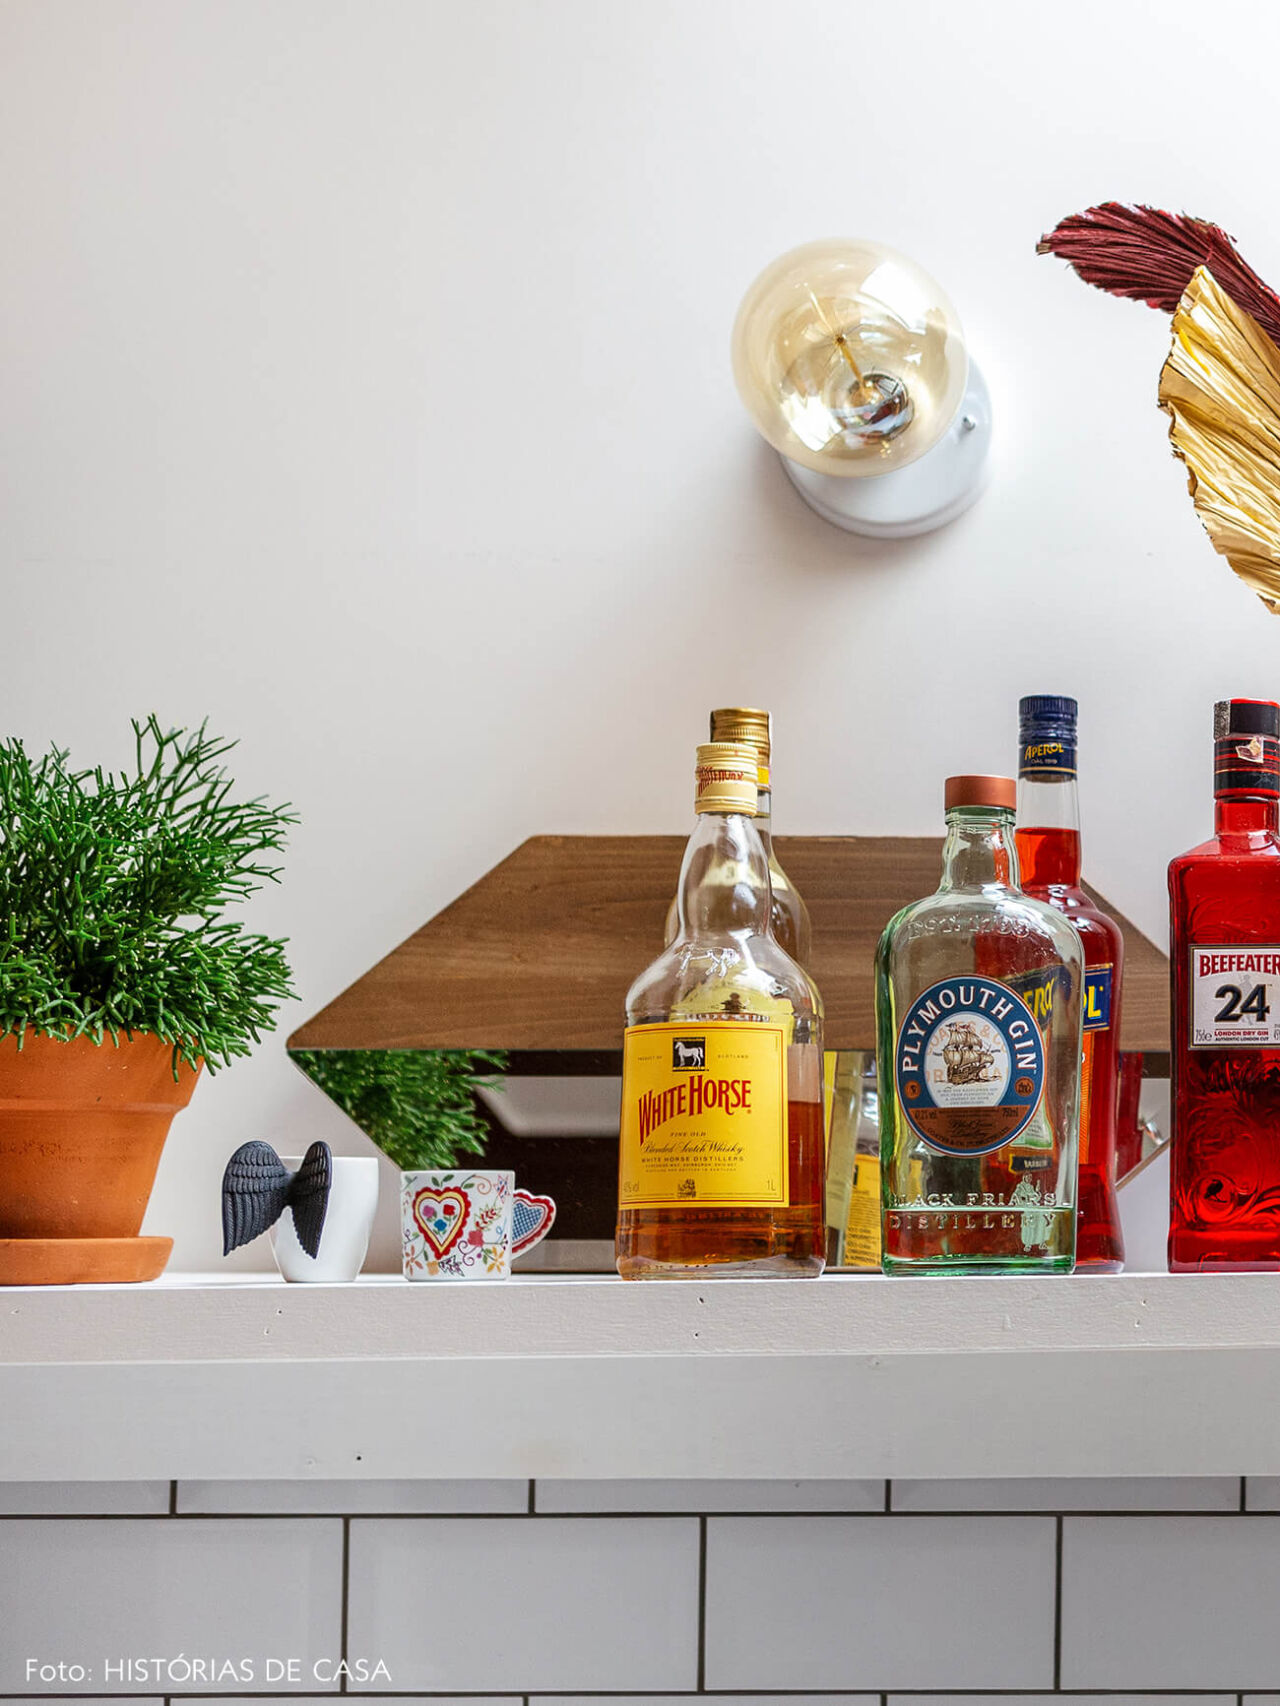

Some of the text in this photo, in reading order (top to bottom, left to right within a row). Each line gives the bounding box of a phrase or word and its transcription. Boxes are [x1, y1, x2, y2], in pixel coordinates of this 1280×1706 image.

[1024, 743, 1064, 760] APEROL
[1214, 983, 1270, 1022] 24
[902, 985, 1037, 1073] PLYMOUTH GIN
[638, 1074, 752, 1147] WHITE HORSE
[707, 1141, 744, 1155] Whisky
[966, 1192, 1057, 1207] FRIARS
